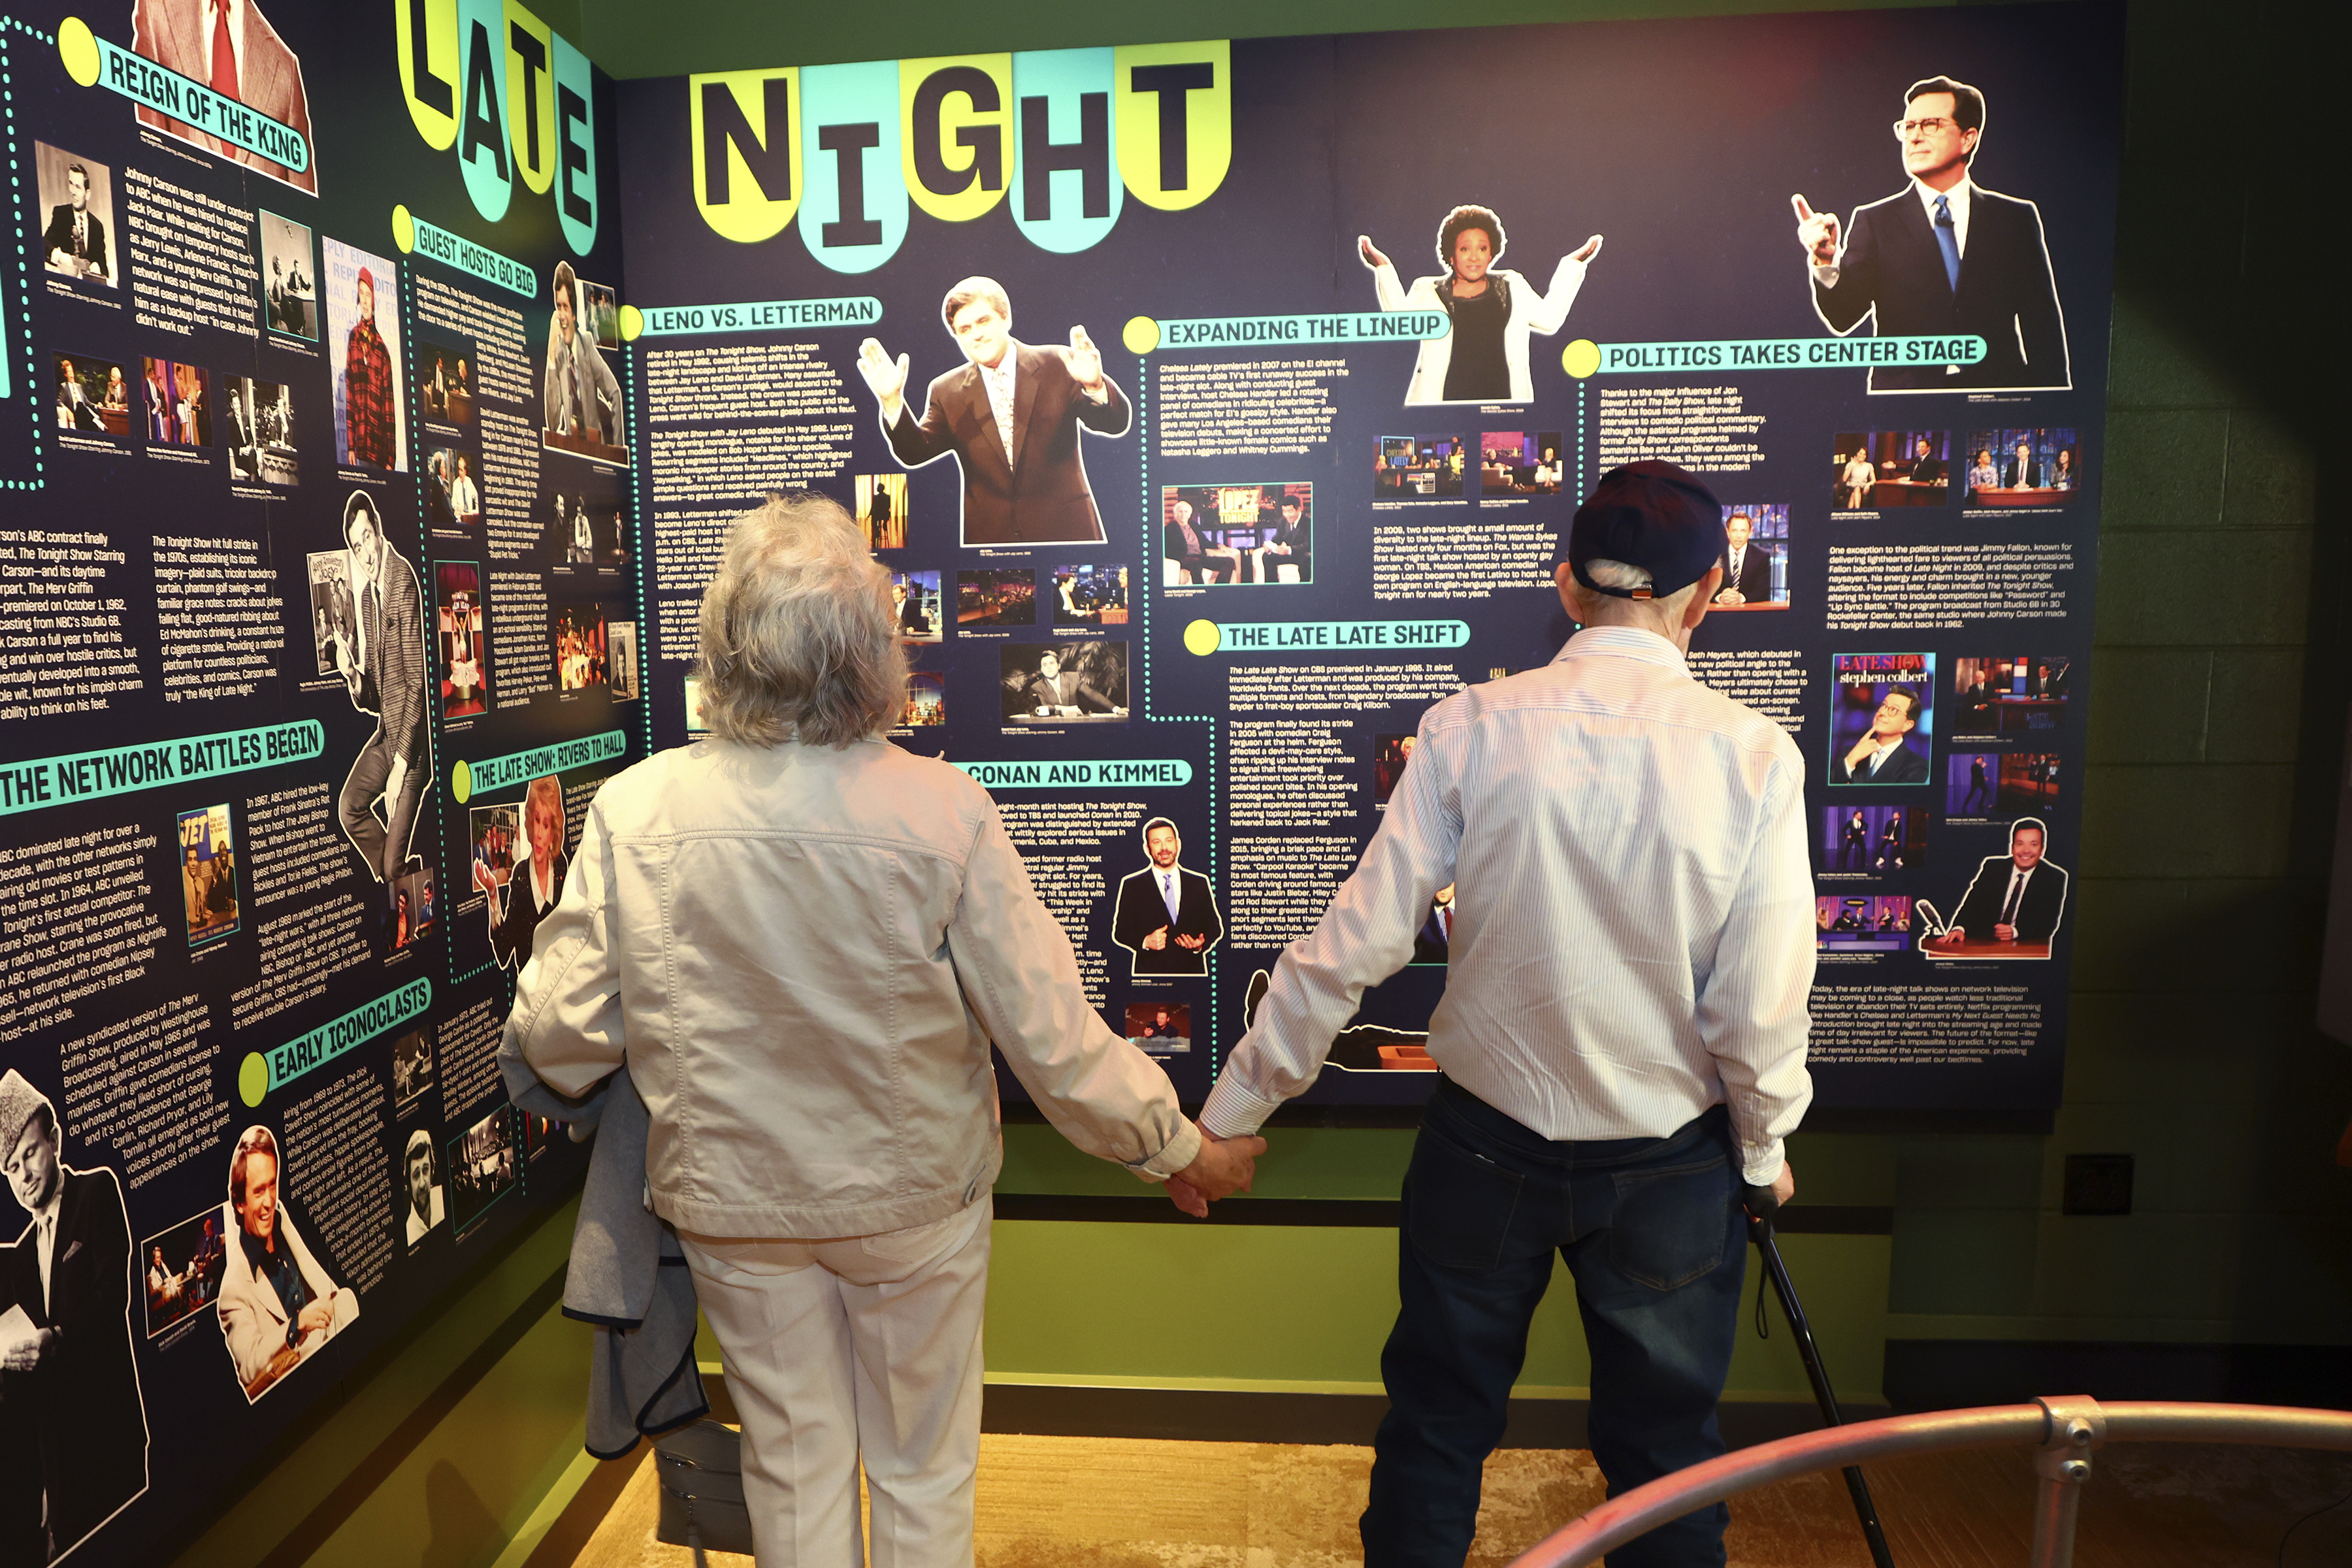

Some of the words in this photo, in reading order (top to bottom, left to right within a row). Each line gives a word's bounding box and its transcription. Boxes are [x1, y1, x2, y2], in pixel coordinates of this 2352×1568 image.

[110, 50, 180, 112] REIGN
[186, 87, 210, 123] OF
[216, 100, 252, 144] THE
[257, 119, 301, 167] KING
[410, 0, 592, 229] LATE
[701, 62, 1215, 248] NIGHT
[124, 166, 152, 189] Johnny
[153, 176, 178, 195] Carson
[179, 188, 193, 201] was
[194, 193, 206, 205] still
[207, 198, 226, 212] under
[227, 205, 255, 222] contract
[419, 225, 456, 262] GUEST
[461, 242, 495, 278] HOSTS
[498, 259, 512, 285] GO
[515, 266, 533, 294] BIG
[652, 310, 704, 331] LENO
[711, 308, 743, 327] VS.
[751, 301, 873, 325] LETTERMAN
[1169, 320, 1299, 343] EXPANDING
[1307, 319, 1348, 338] THE
[1356, 316, 1441, 337] LINEUP
[647, 350, 662, 359] After
[664, 350, 674, 358] 30
[675, 350, 694, 359] years
[720, 346, 745, 357] Tonight
[745, 346, 766, 356] Show,
[767, 344, 792, 355] Johnny
[1610, 346, 1722, 367] POLITICS
[1730, 343, 1801, 364] TAKES
[1808, 342, 1899, 363] CENTER
[1905, 339, 1978, 361] STAGE
[1160, 364, 1188, 372] Chelsea
[1190, 363, 1212, 372] Lately
[1213, 361, 1251, 372] premiered
[1261, 361, 1279, 369] 2007
[1315, 358, 1345, 367] channel
[1601, 389, 1627, 397] Thanks
[1654, 387, 1675, 397] major
[1677, 387, 1712, 395] influence
[1713, 385, 1722, 395] of
[1723, 386, 1737, 395] Jon
[1390, 457, 1409, 466] LATELY
[1218, 487, 1260, 513] LOPEZ
[1218, 512, 1260, 523] TONIGHT
[1383, 526, 1405, 536] 2009,
[1448, 525, 1476, 534] brought
[1505, 523, 1534, 532] amount
[1535, 523, 1544, 531] of
[27, 531, 45, 542] ABC
[46, 532, 83, 544] contract
[84, 531, 107, 547] finally
[152, 535, 165, 546] The
[167, 536, 192, 550] Tonight
[193, 537, 211, 547] Show
[212, 538, 221, 548] hit
[222, 538, 232, 549] full
[233, 539, 251, 549] stride
[252, 540, 257, 549] in
[1846, 546, 1884, 555] exception
[1908, 545, 1939, 554] political
[1980, 544, 2006, 553] Jimmy
[1228, 627, 1269, 646] THE
[1277, 627, 1328, 645] LATE
[1336, 626, 1386, 645] LATE
[1394, 625, 1461, 644] SHIFT
[1840, 655, 1880, 670] LATE
[1882, 654, 1929, 670] SHOW
[1840, 670, 1886, 688] stephen
[1887, 669, 1928, 682] colbert
[1244, 721, 1274, 729] program
[1276, 720, 1297, 729] finally
[1331, 719, 1353, 727] stride
[0, 765, 51, 807] THE
[57, 746, 175, 797] NETWORK
[180, 733, 261, 776] BATTLES
[266, 724, 319, 760] BEGIN
[474, 763, 496, 789] THE
[498, 757, 522, 783] LATE
[525, 750, 555, 776] SHOW:
[558, 741, 589, 768] RIVERS
[591, 738, 602, 759] TO
[604, 733, 623, 755] HALL
[968, 766, 1040, 783] CONAN
[1048, 765, 1091, 783] AND
[1099, 764, 1183, 782] KIMMEL
[246, 798, 253, 808] In
[254, 794, 270, 806] 1967,
[270, 791, 282, 802] ABC
[282, 787, 297, 800] hired
[298, 787, 307, 796] the
[308, 782, 329, 796] low-key
[997, 802, 1039, 813] eight-month
[1058, 802, 1084, 812] hosting
[1100, 802, 1126, 812] Tonight
[1126, 802, 1147, 812] Show,
[180, 815, 208, 847] JET
[60, 1043, 66, 1054] A
[67, 1037, 84, 1052] new
[86, 1018, 129, 1045] syndicated
[131, 1009, 157, 1026] version
[159, 1003, 166, 1015] of
[168, 1000, 180, 1011] The
[182, 993, 198, 1006] Merv
[274, 1031, 323, 1082] EARLY
[328, 982, 427, 1054] ICONOCLASTS
[284, 1104, 299, 1120] Airing
[299, 1098, 312, 1111] from
[314, 1088, 325, 1103] 1969
[327, 1086, 332, 1095] to
[333, 1078, 346, 1096] 1973,
[346, 1073, 355, 1083] The
[357, 1066, 367, 1079] Dick
